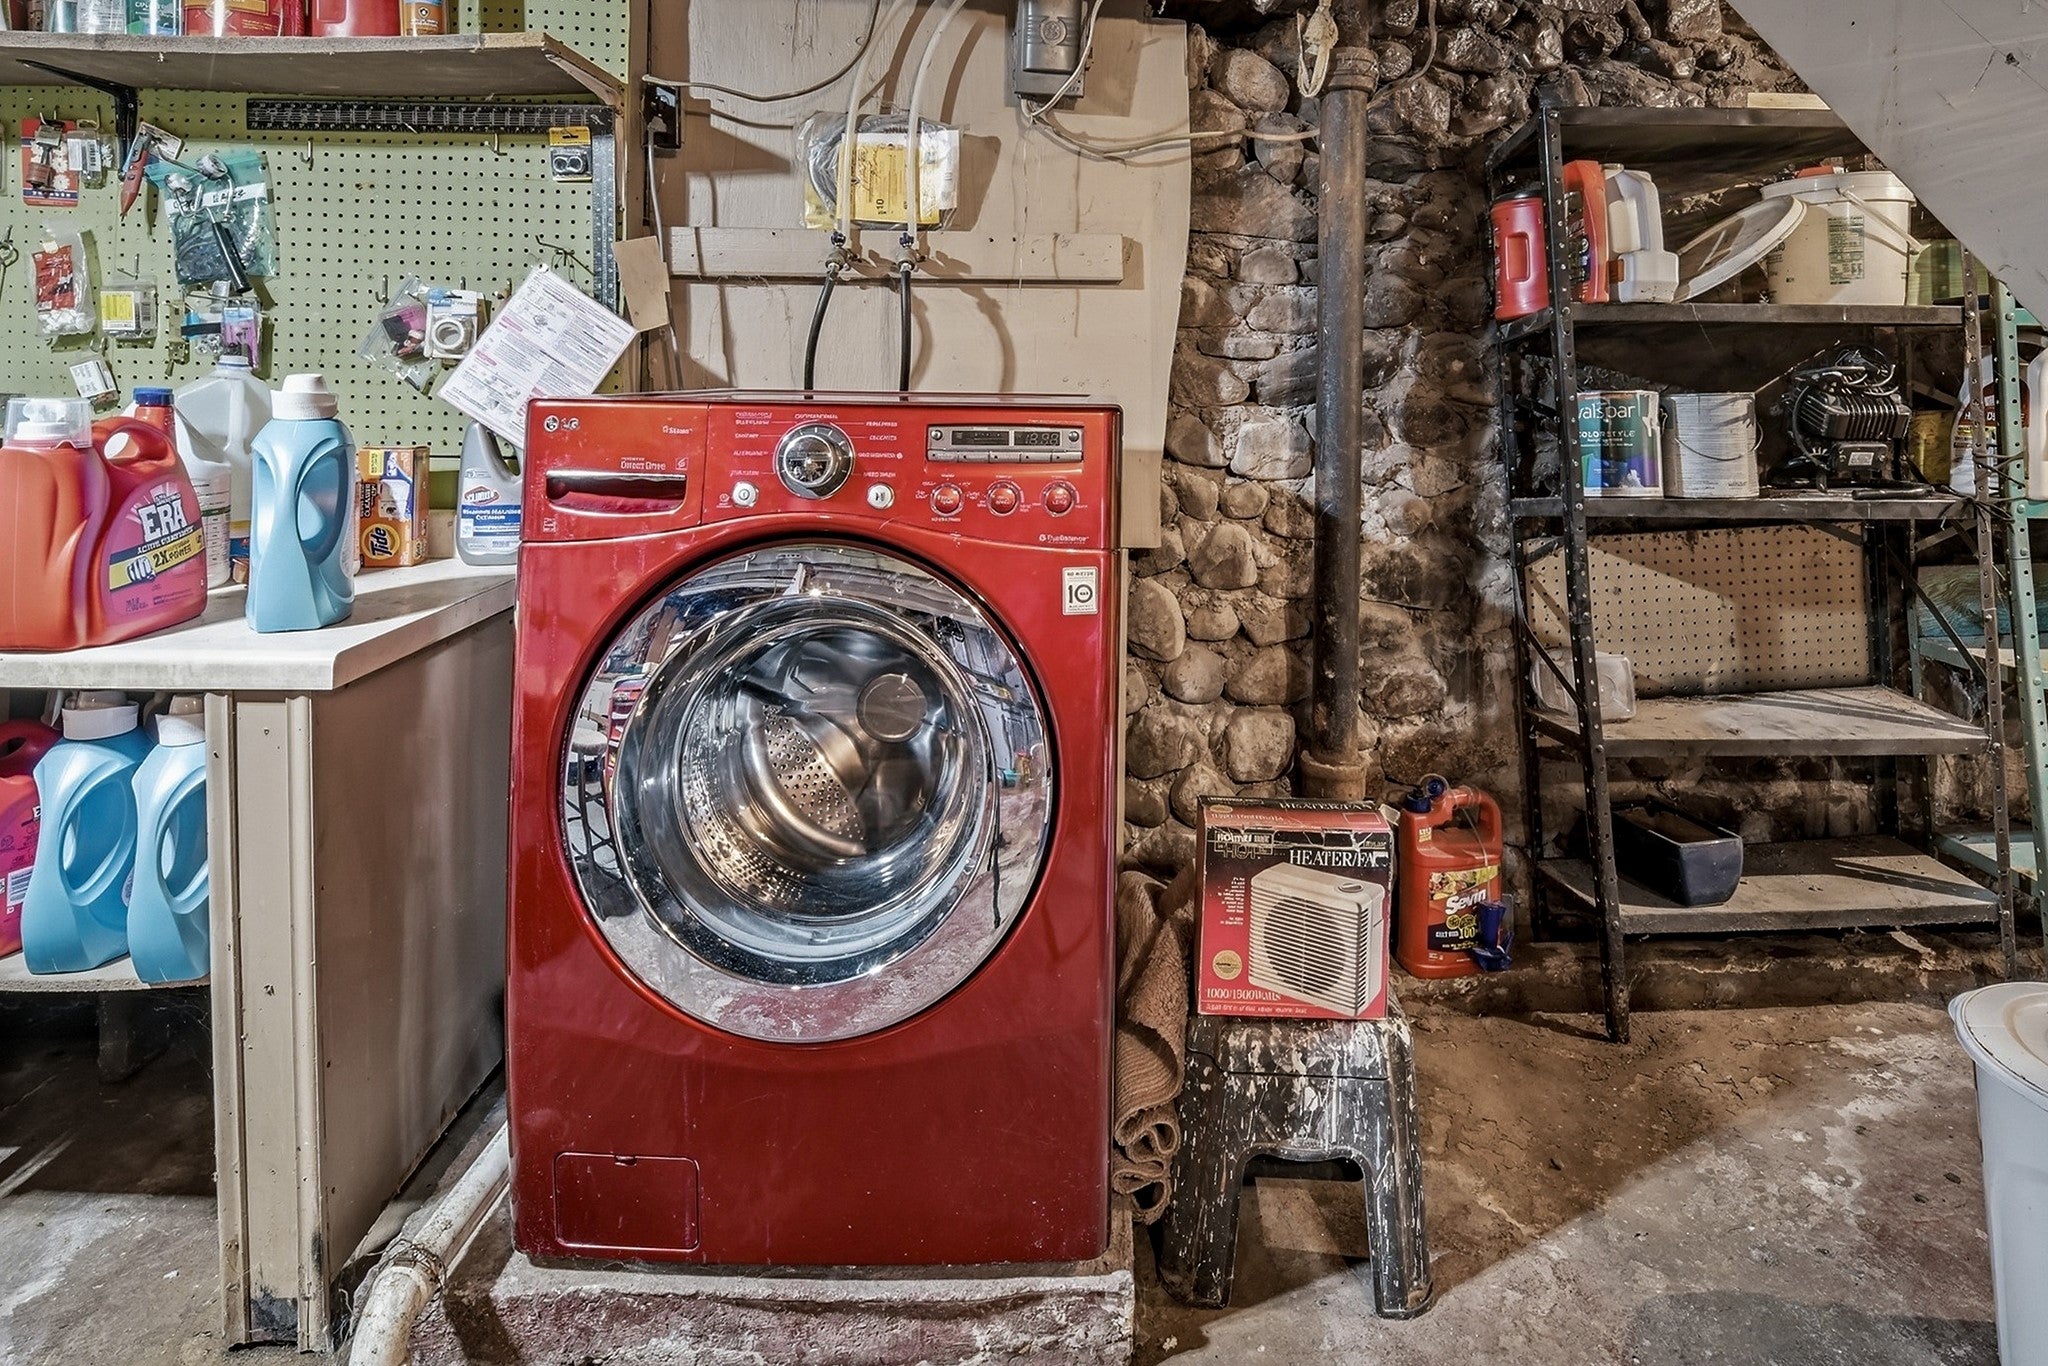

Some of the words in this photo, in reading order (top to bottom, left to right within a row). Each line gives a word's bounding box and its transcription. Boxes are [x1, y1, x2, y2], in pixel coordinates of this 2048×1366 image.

[138, 498, 188, 542] ERA
[369, 526, 393, 556] Tide
[152, 550, 169, 568] 2X
[1067, 584, 1093, 603] 10
